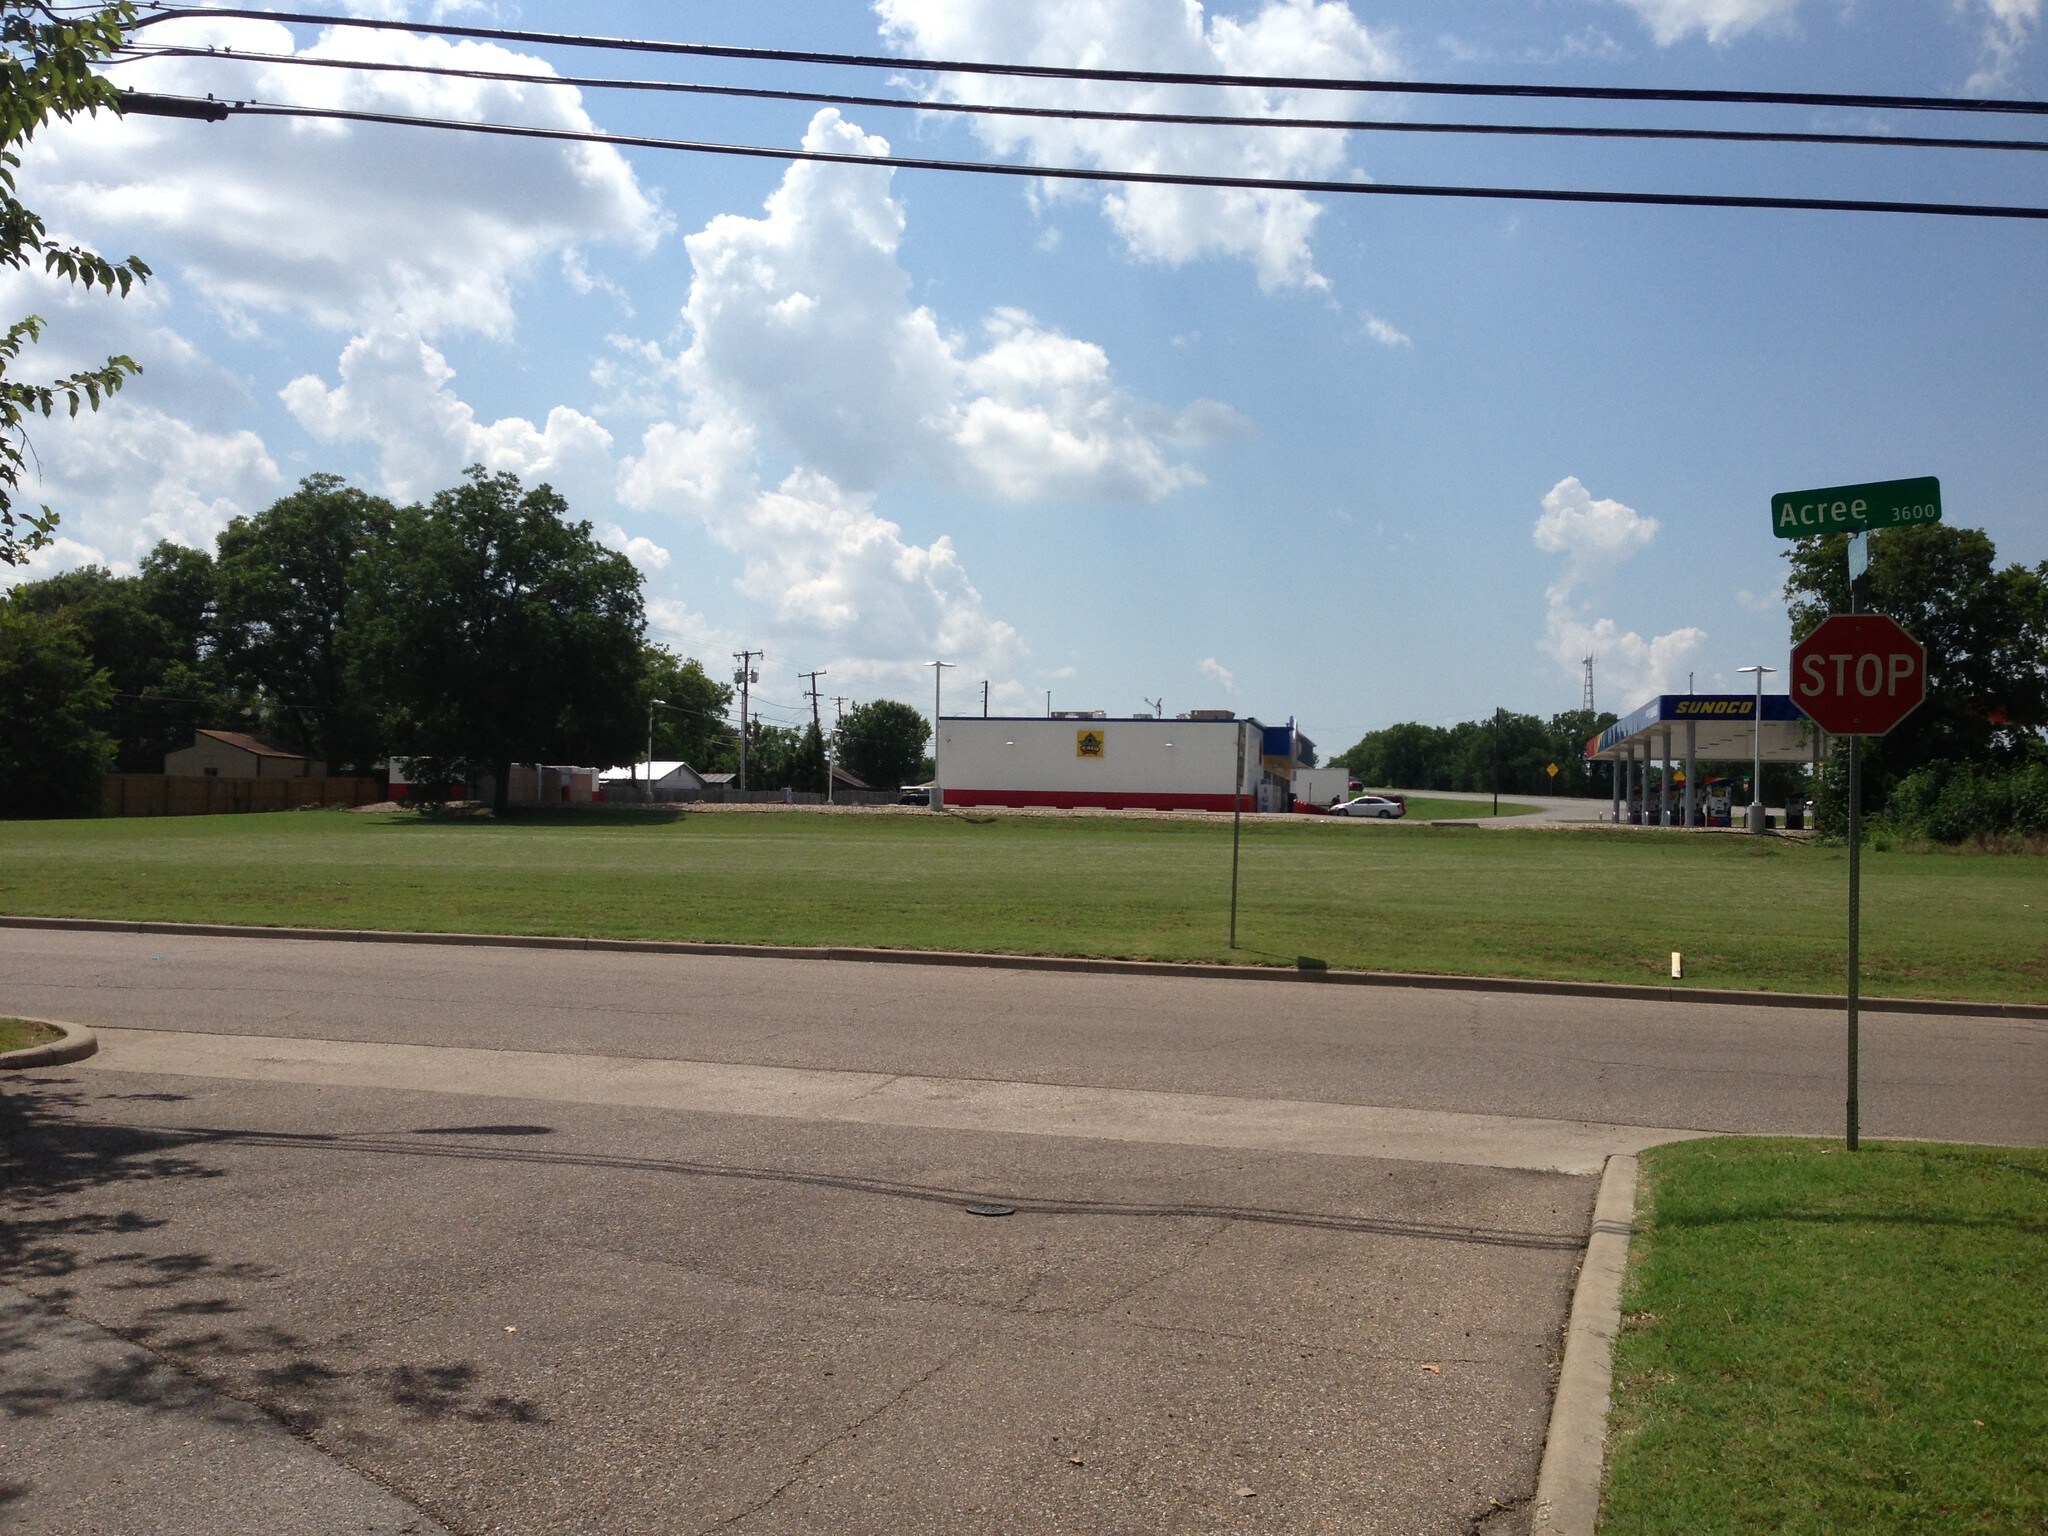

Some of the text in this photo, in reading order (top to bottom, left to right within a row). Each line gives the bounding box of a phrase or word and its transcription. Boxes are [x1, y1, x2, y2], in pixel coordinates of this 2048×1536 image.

[1779, 498, 1935, 527] Acree 3600
[1800, 653, 1915, 697] STOP
[1675, 701, 1753, 714] SUNOCO
